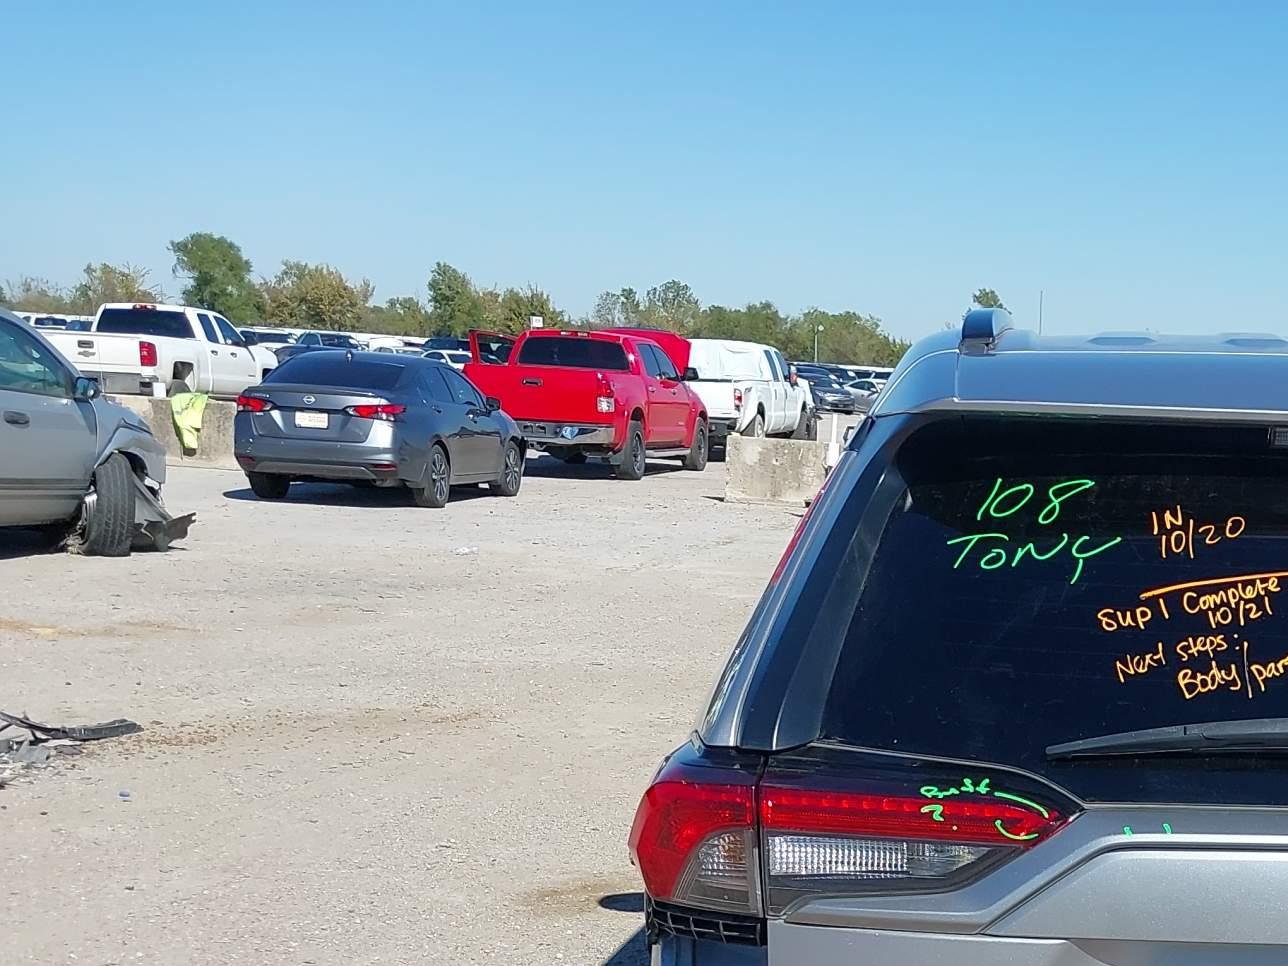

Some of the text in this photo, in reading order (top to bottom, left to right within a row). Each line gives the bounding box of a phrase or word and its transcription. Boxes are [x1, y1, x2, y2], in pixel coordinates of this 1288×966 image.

[976, 477, 1096, 525] 108
[1151, 504, 1183, 536] IN
[1160, 516, 1246, 559] 10/20
[1183, 576, 1282, 614] Complete
[1208, 596, 1274, 629] 10/21
